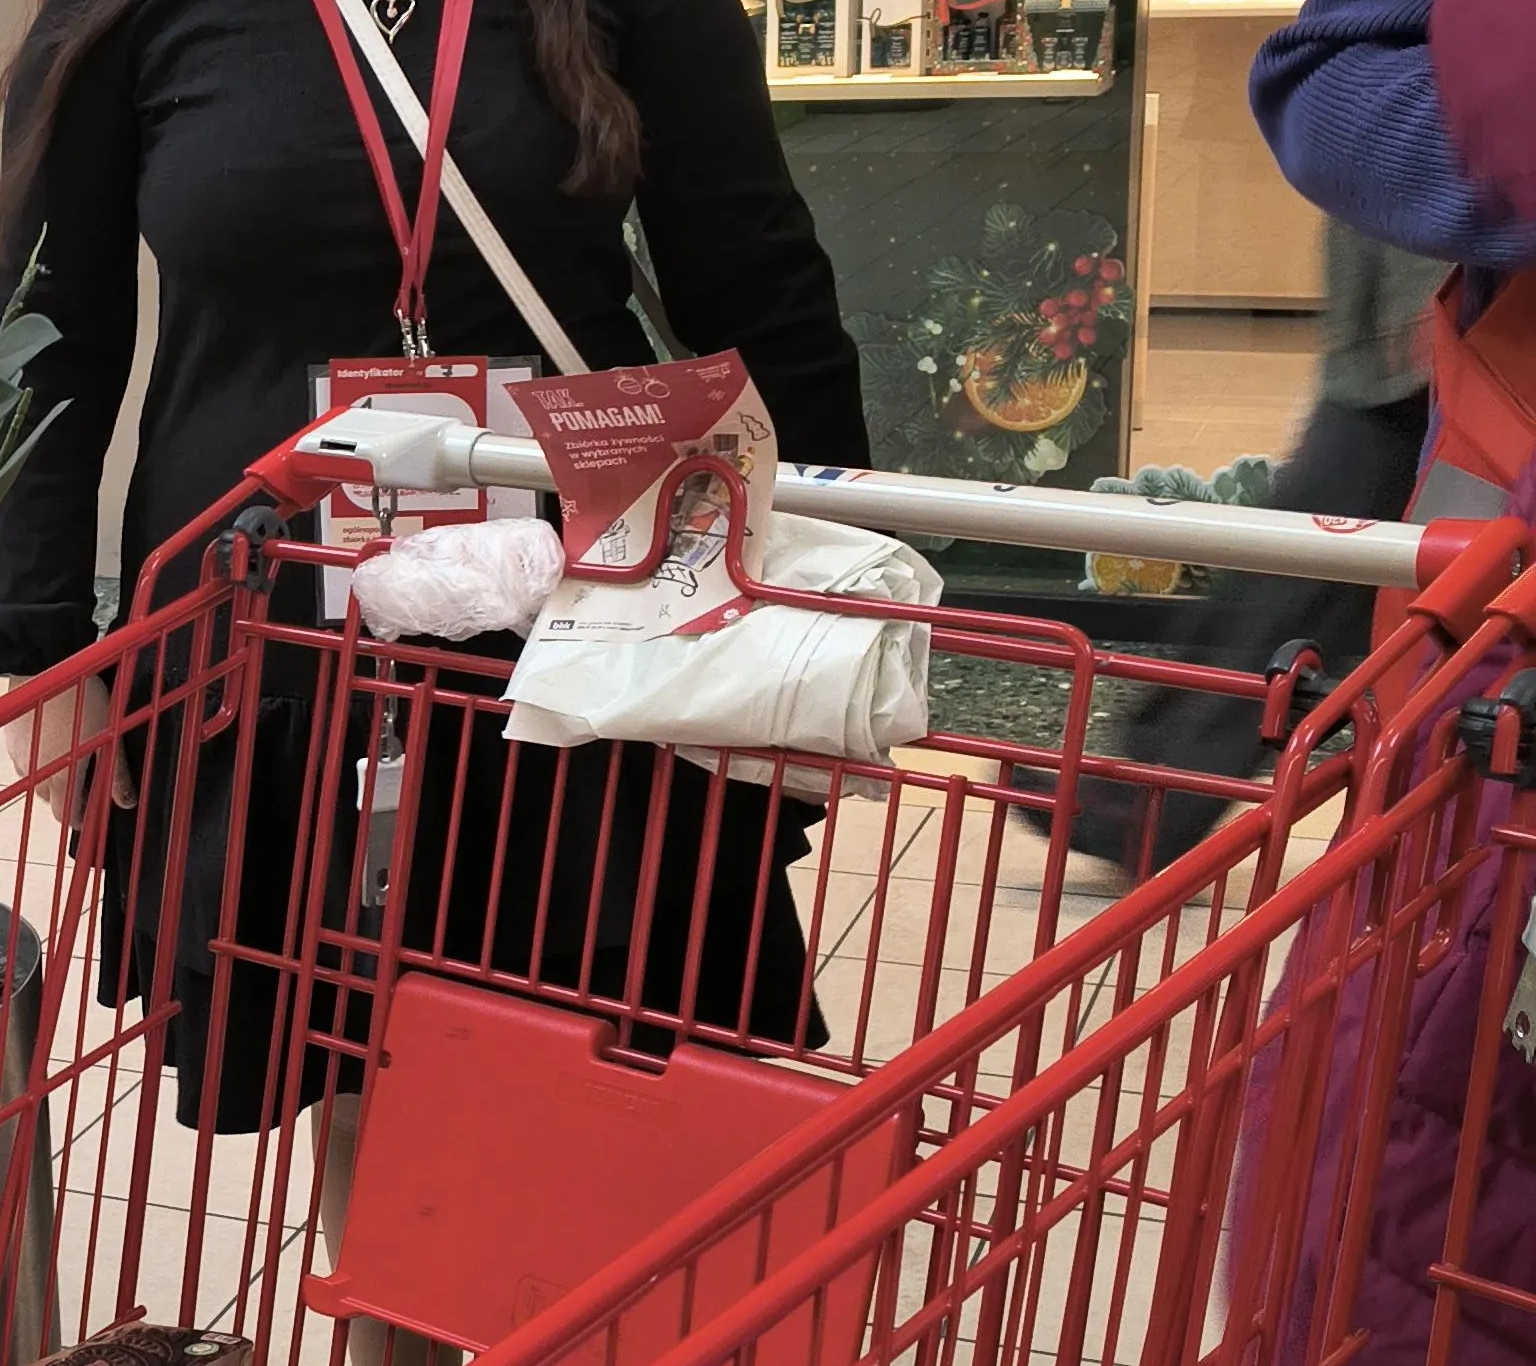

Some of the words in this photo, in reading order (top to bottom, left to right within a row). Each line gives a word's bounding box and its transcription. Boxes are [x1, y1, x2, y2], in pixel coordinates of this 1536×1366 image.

[337, 368, 404, 380] Identyfikator
[549, 404, 666, 432] POMAGAM!
[564, 438, 609, 451] Zbiórka
[611, 434, 665, 448] żywności
[582, 445, 648, 460] wybranych
[573, 456, 628, 471] sklepach
